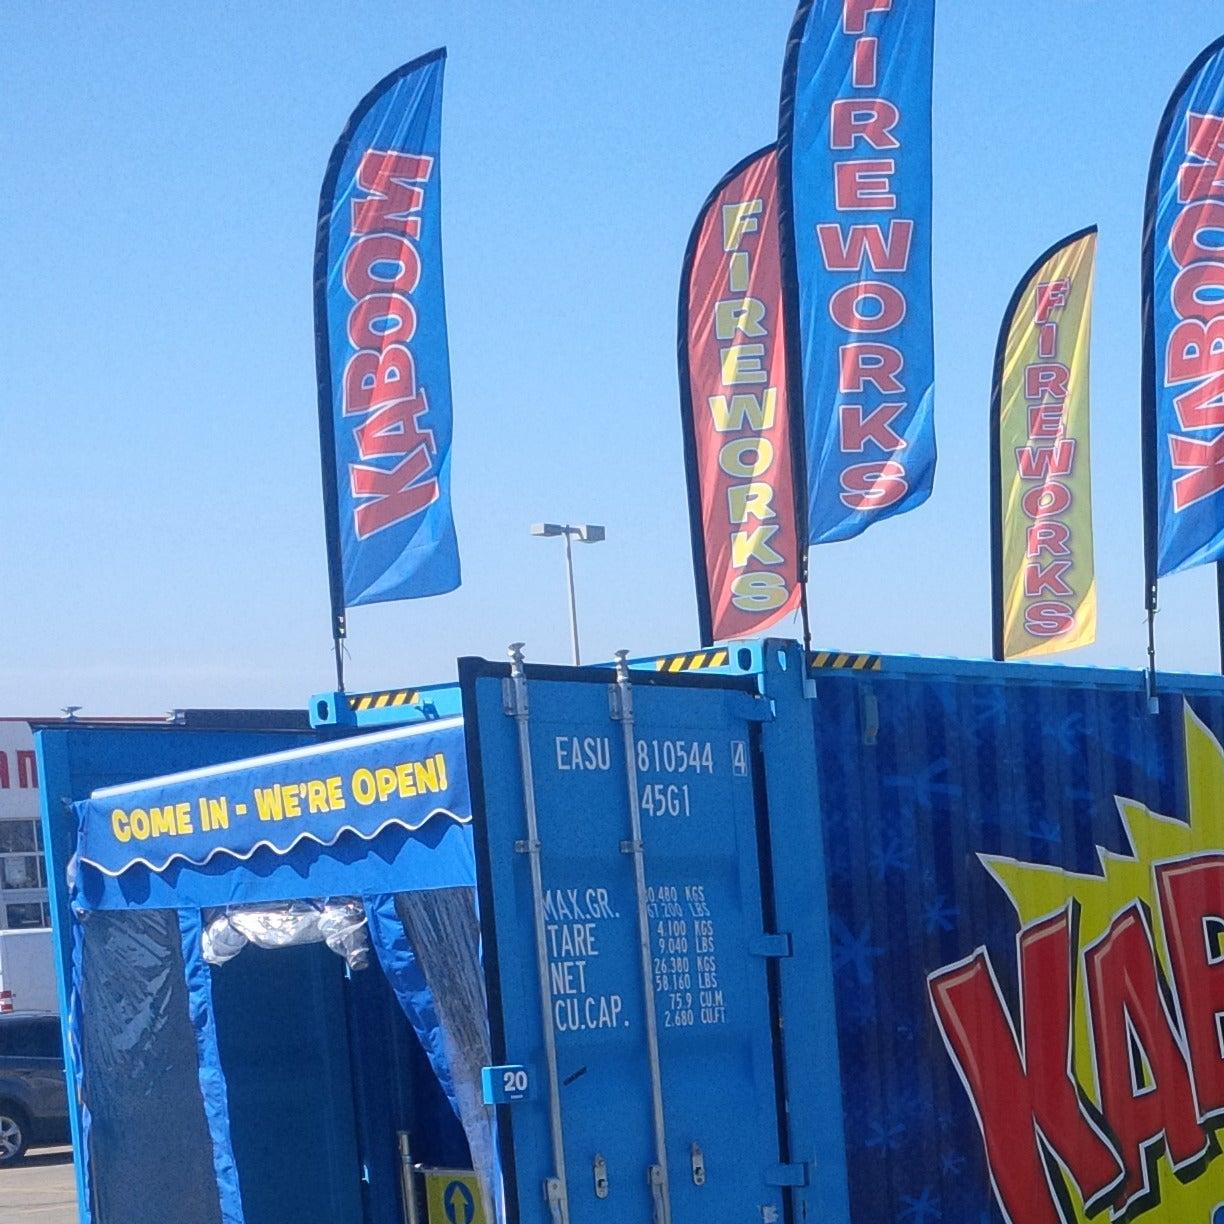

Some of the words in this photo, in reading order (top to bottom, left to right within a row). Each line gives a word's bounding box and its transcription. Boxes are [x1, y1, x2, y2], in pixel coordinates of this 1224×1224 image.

[343, 150, 440, 540] KABOOM
[709, 200, 789, 612] FIREWORKS
[1016, 279, 1079, 638] FIREWORKS
[556, 737, 611, 770] EASU
[638, 740, 714, 774] 810544
[732, 742, 748, 775] 4
[112, 803, 193, 843] COME
[200, 797, 229, 830] IN
[254, 776, 345, 822] WE'RE
[351, 754, 448, 802] OPEN!
[642, 784, 690, 817] 45G1
[685, 886, 705, 902] KGS
[688, 902, 710, 917] LBS
[547, 923, 599, 957] TARE
[694, 920, 713, 936] KGS
[695, 937, 714, 953] LBS
[551, 960, 586, 995] NET
[697, 956, 716, 973] KGS
[698, 973, 717, 989] LBS
[504, 1071, 528, 1091] 20
